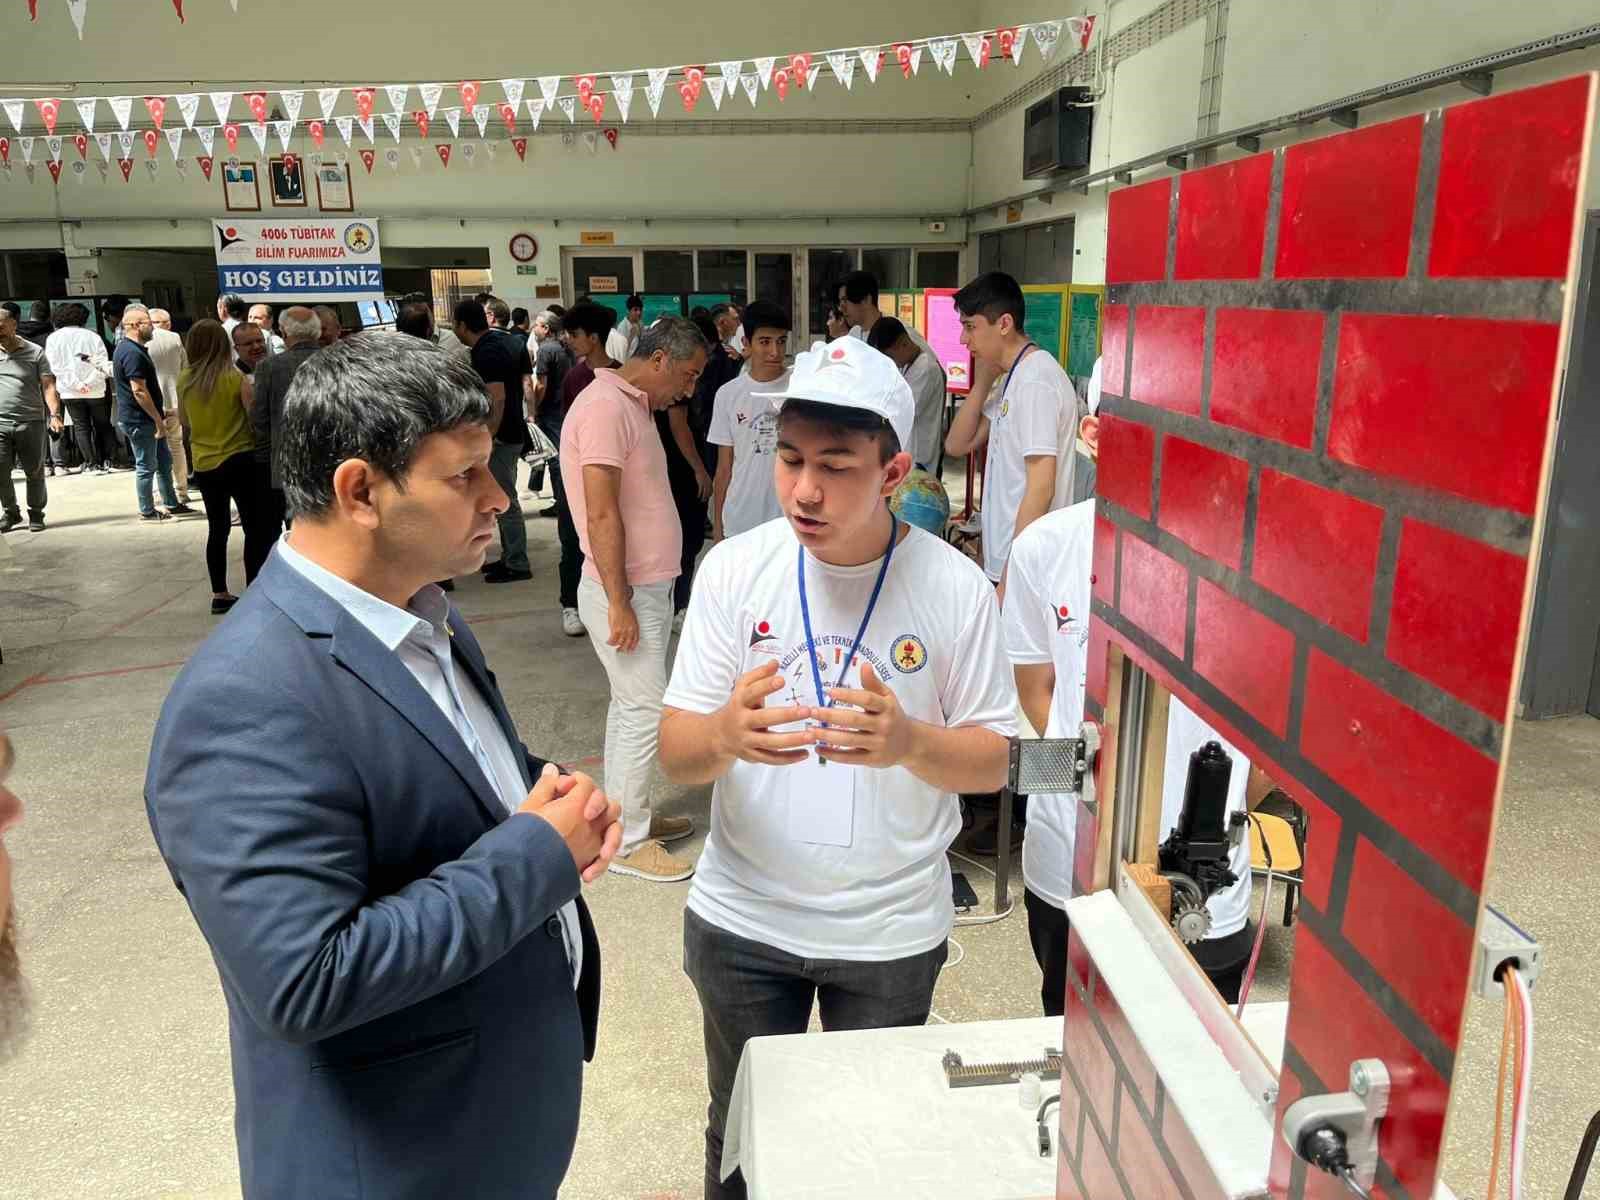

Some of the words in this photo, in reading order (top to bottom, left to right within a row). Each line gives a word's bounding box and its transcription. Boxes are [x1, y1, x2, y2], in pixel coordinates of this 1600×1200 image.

[261, 228, 287, 240] 4006
[290, 225, 336, 240] TÜBİTAK
[255, 244, 286, 258] BİLİM
[288, 246, 346, 258] FUARIMIZA
[224, 270, 272, 291] HOŞ
[276, 265, 380, 288] GELDİNİZ
